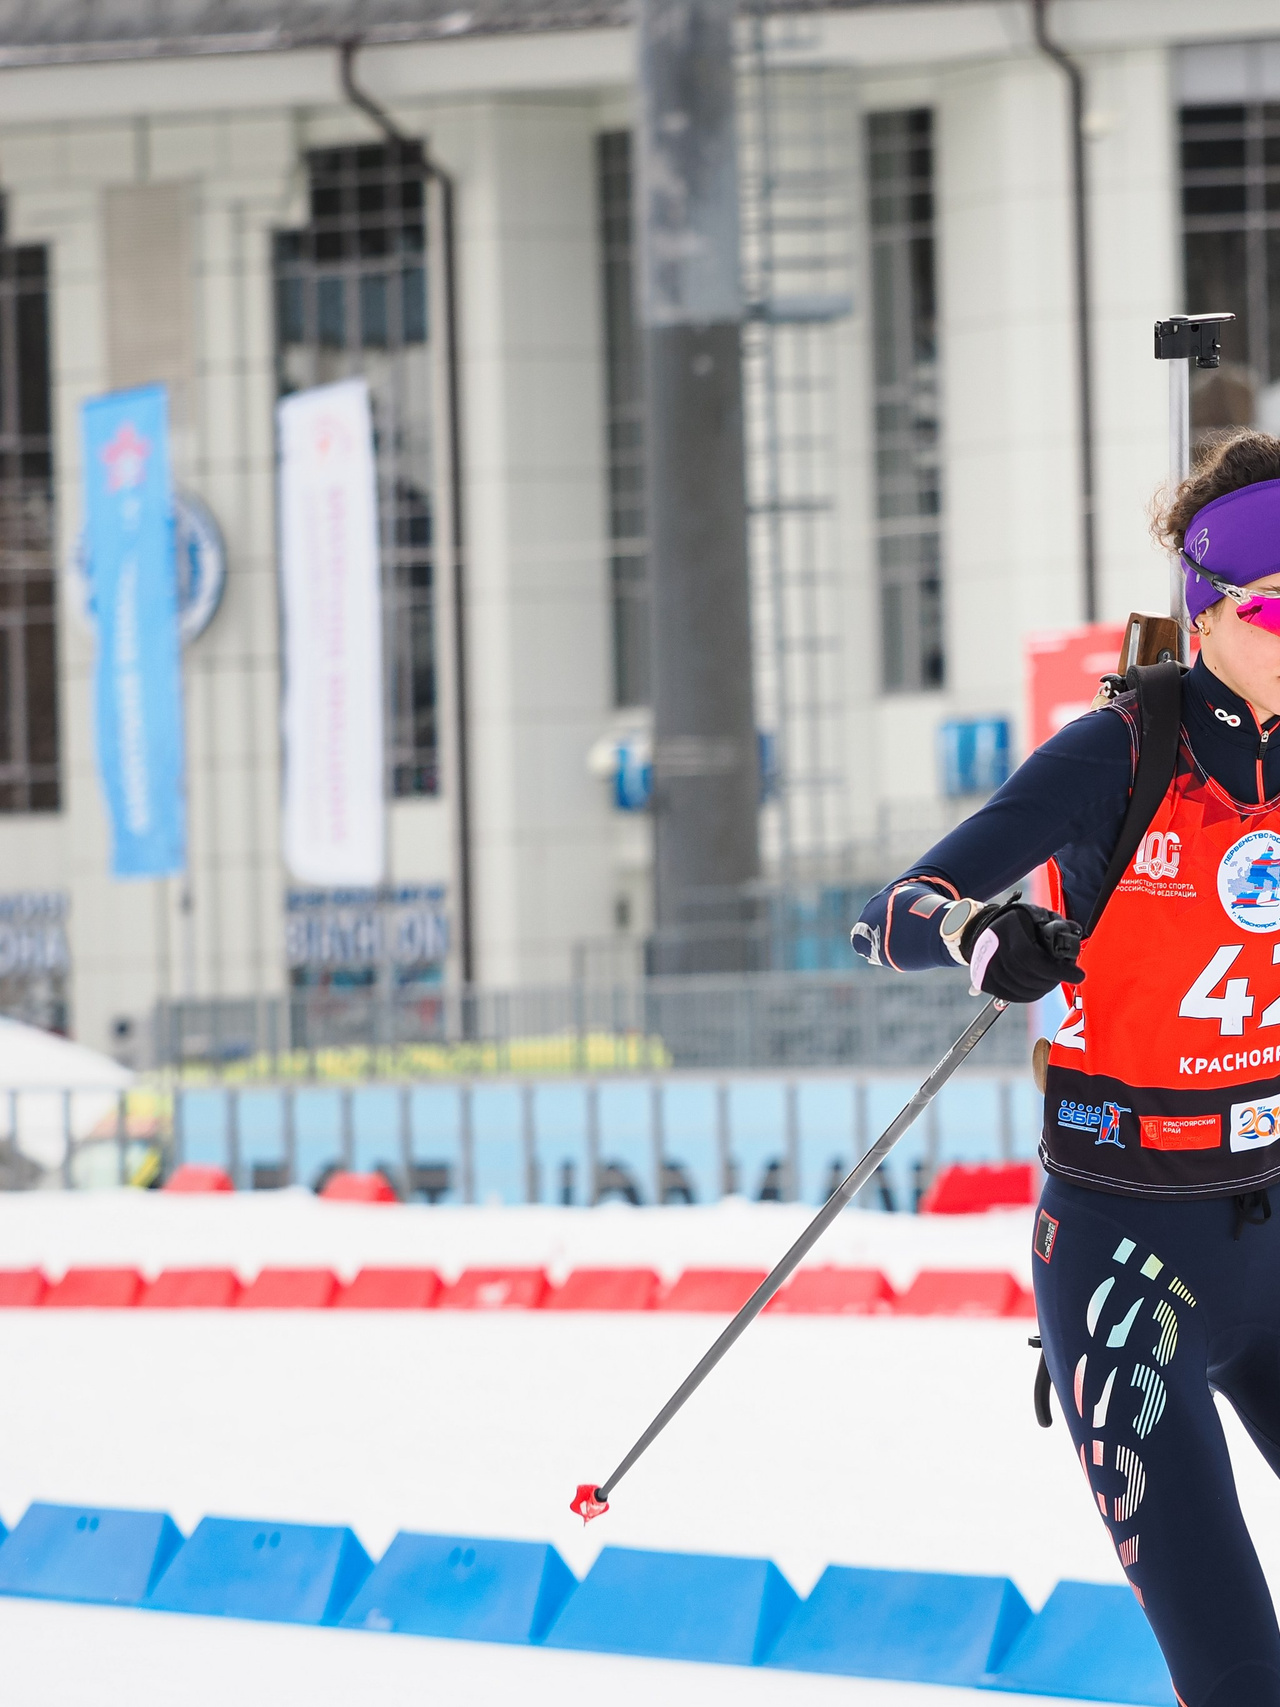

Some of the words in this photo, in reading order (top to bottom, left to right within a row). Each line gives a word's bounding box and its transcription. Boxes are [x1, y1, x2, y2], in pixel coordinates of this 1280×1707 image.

[1223, 832, 1269, 866] ПЕРВЕНСТВО
[1116, 885, 1156, 896] РОССИЙСКОЙ
[1120, 879, 1168, 889] МИНИСТЕРСТВО
[1237, 914, 1277, 929] Красноярск
[1058, 1107, 1101, 1126] СБР
[1163, 1118, 1216, 1127] КРАСНОЯРСКИЙ
[1044, 1222, 1056, 1258] COURSE
